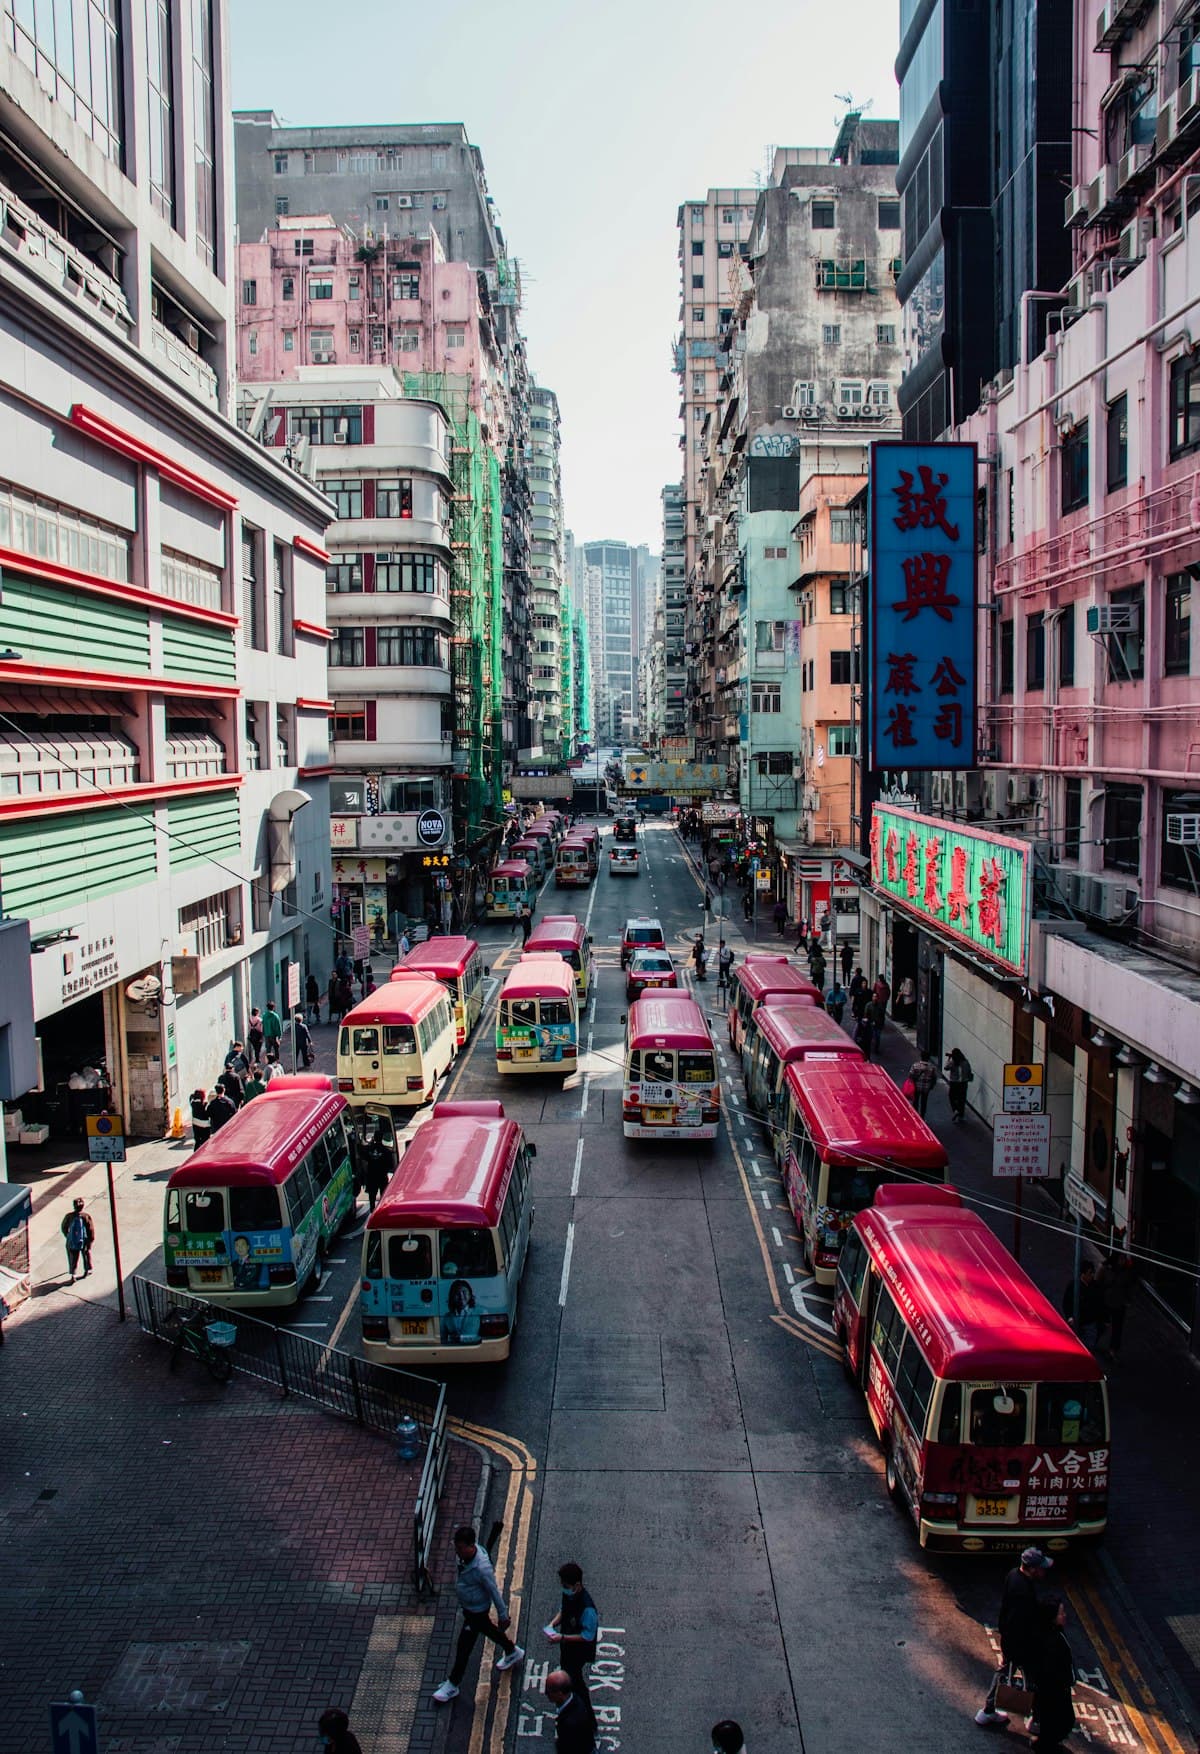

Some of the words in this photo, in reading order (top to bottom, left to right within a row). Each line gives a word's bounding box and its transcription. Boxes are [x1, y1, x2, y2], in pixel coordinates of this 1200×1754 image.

[892, 465, 960, 623] 誠興
[928, 655, 967, 748] 公司
[421, 819, 443, 829] NOVA
[332, 823, 346, 837] 祥
[1028, 1088, 1035, 1096] 7
[1028, 1102, 1040, 1111] 12
[110, 1138, 117, 1146] 7
[112, 1151, 123, 1160] 12
[1029, 1449, 1110, 1474] 八合里
[977, 1506, 1006, 1516] 3233
[589, 1626, 626, 1691] LOOK
